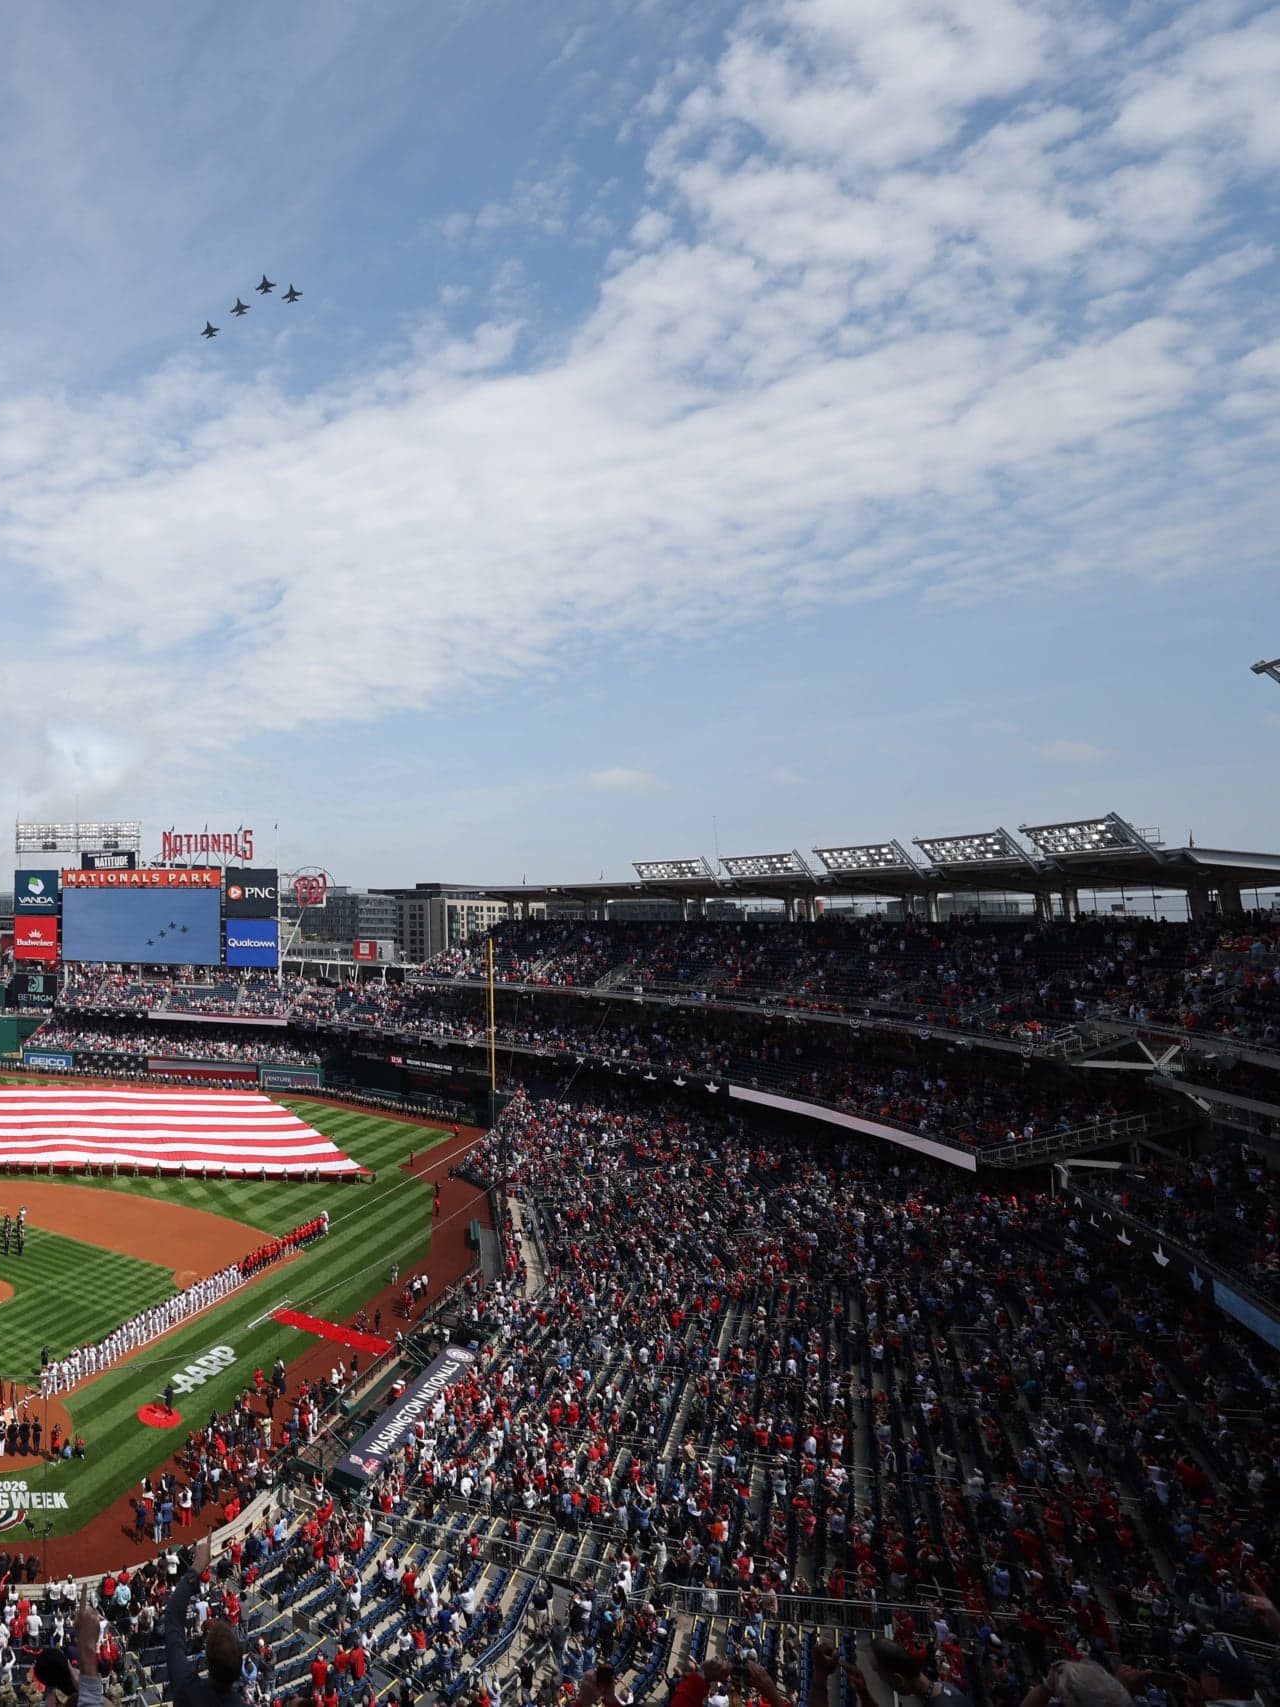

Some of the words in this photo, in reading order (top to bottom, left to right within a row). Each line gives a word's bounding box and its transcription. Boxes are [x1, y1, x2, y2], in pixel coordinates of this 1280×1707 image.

[162, 830, 253, 861] NATIONALS
[94, 856, 129, 868] NATITUDE
[67, 872, 160, 884] NATIONALS
[168, 872, 213, 883] PARK
[245, 887, 276, 900] PNC
[18, 896, 55, 905] VANDA
[16, 938, 54, 948] Budweiser
[228, 938, 276, 949] Qualcomm
[17, 993, 54, 1002] BETMGM
[29, 1057, 66, 1067] GEICO
[171, 1346, 238, 1394] AARP
[365, 1398, 425, 1455] WASHINGTON
[416, 1360, 461, 1401] NATIONALS
[11, 1491, 69, 1509] WEEK
